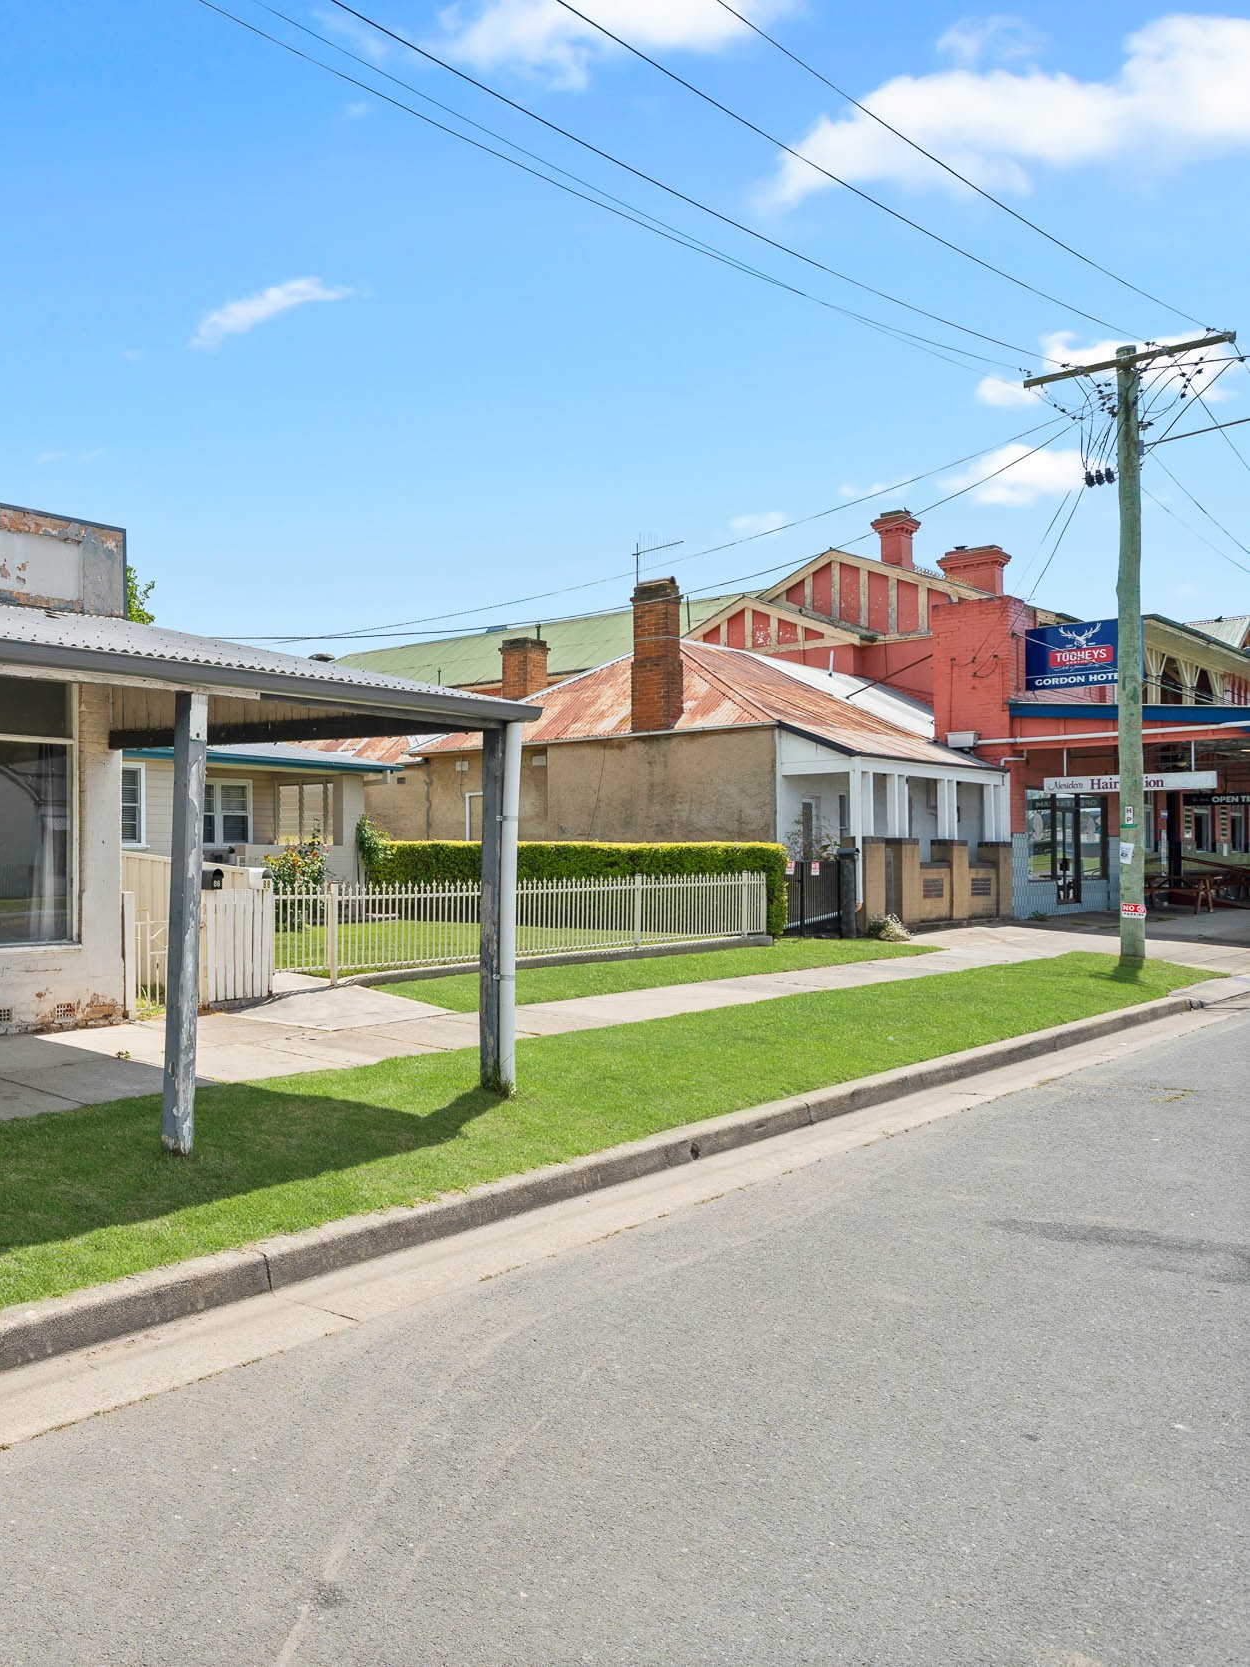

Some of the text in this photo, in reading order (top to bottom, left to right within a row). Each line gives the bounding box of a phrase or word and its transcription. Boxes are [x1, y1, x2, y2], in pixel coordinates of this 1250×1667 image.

[1055, 648, 1107, 662] TOOHEYS
[1035, 673, 1118, 686] GORDON HOTE
[1089, 777, 1120, 790] Hair
[1211, 795, 1239, 804] OPEN
